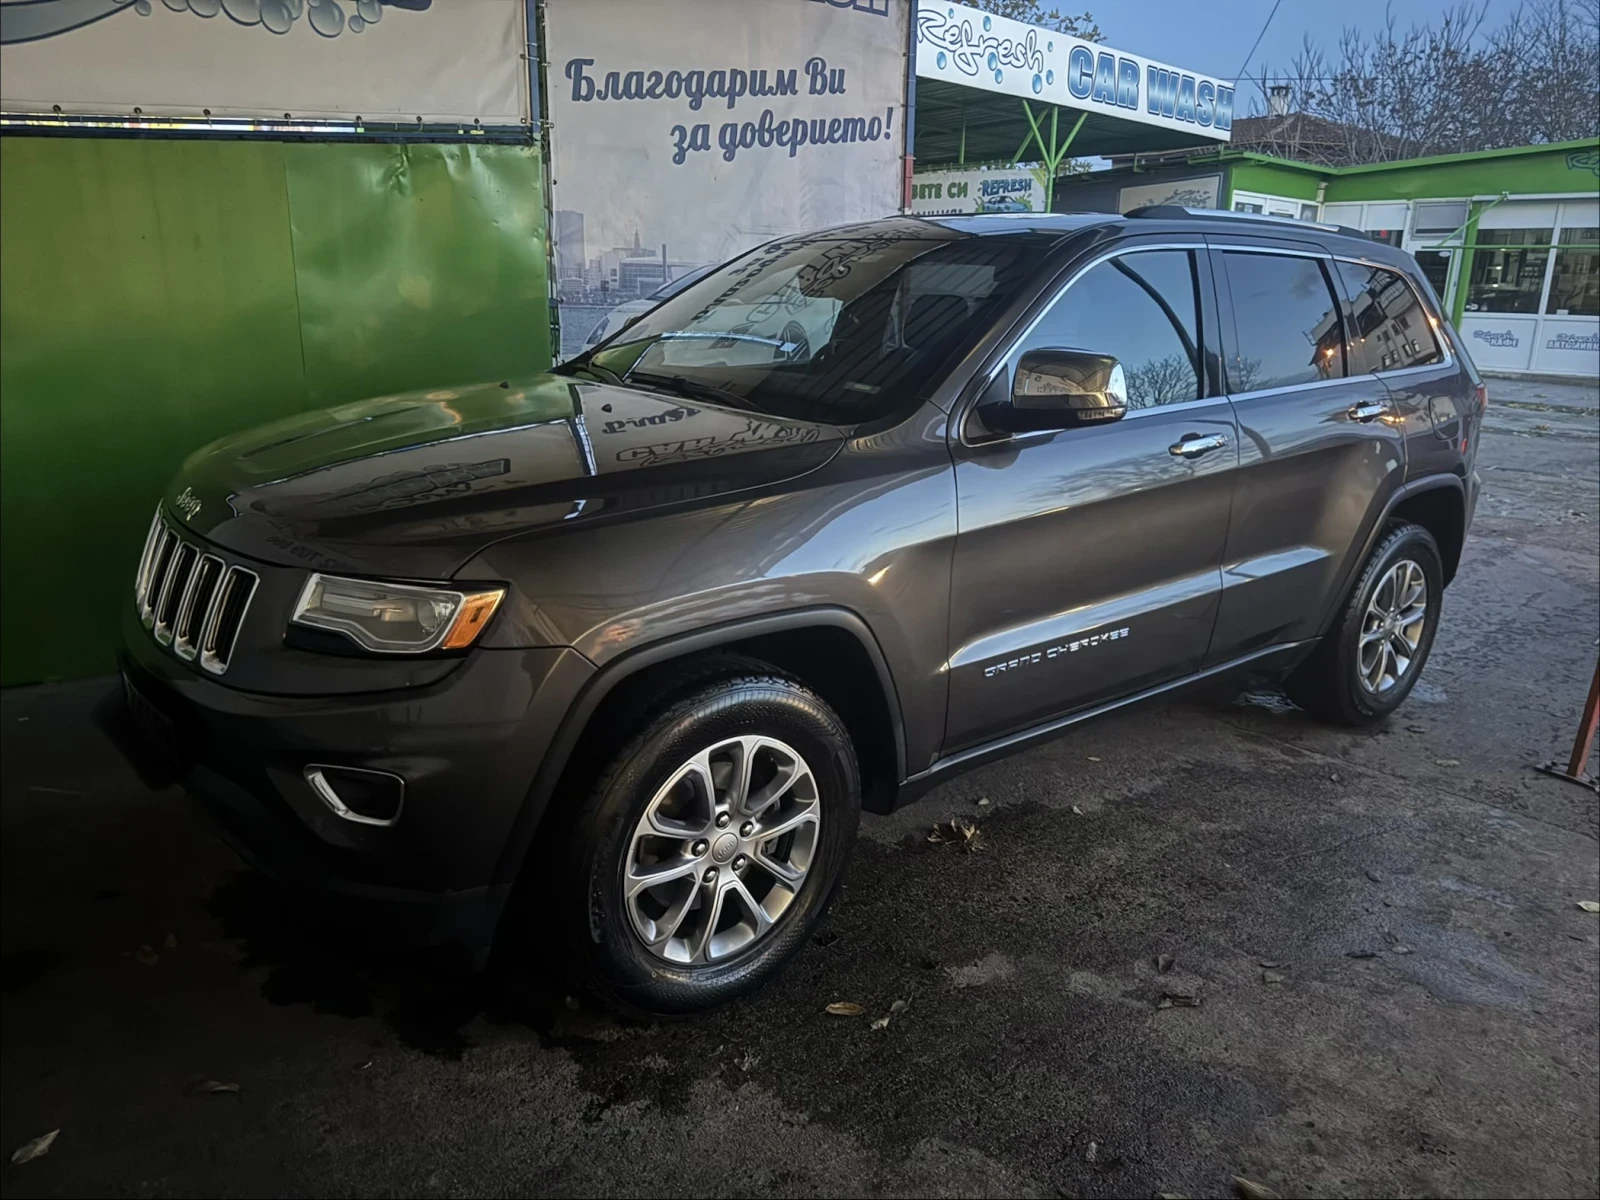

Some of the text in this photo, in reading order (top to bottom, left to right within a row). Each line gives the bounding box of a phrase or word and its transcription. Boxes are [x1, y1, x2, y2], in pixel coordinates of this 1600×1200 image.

[565, 57, 846, 111] Благодарим Ви
[917, 9, 1235, 131] Refresh CAR WASH
[670, 107, 894, 165] за доверието!
[981, 178, 1033, 197] REFRESH
[984, 627, 1130, 677] GRAND CHEROKEE
